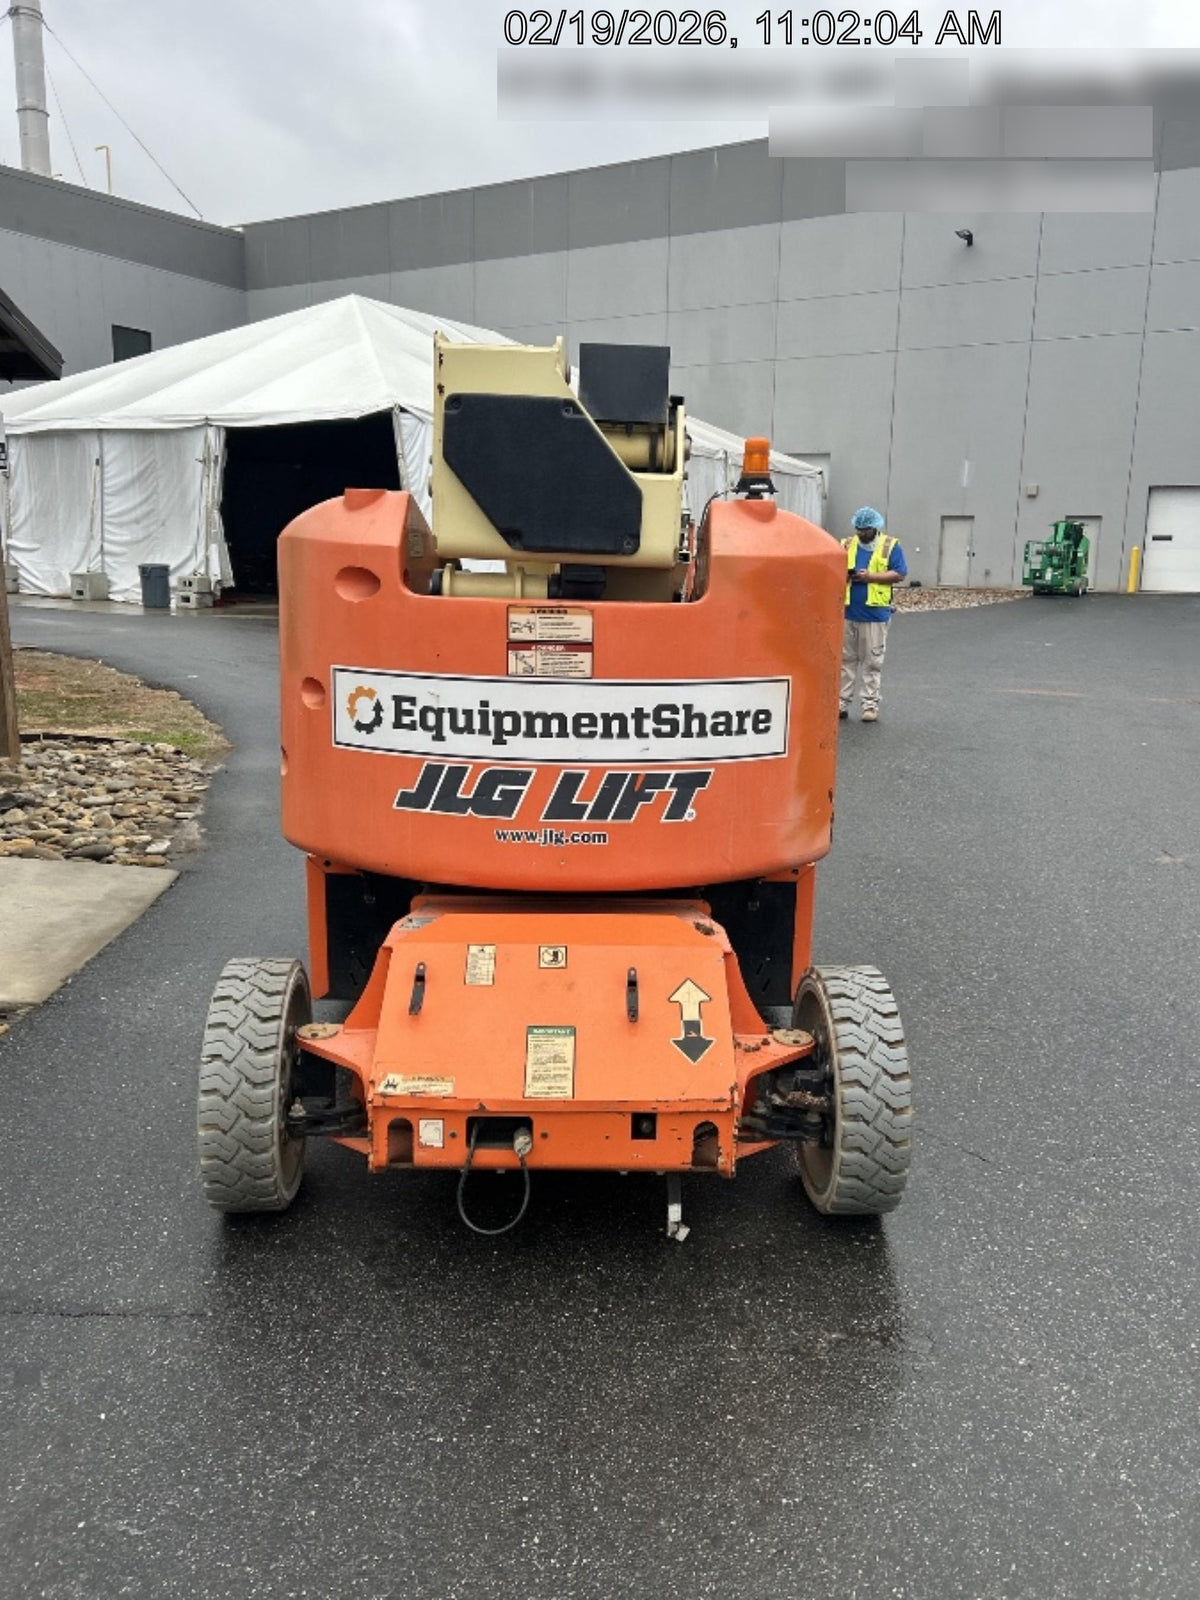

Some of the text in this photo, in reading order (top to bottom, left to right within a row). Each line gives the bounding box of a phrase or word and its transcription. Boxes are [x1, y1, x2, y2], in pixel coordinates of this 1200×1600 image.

[391, 695, 772, 745] EquipmentShare
[394, 762, 714, 822] JLG LIFT
[494, 828, 608, 846] www.jlg.com
